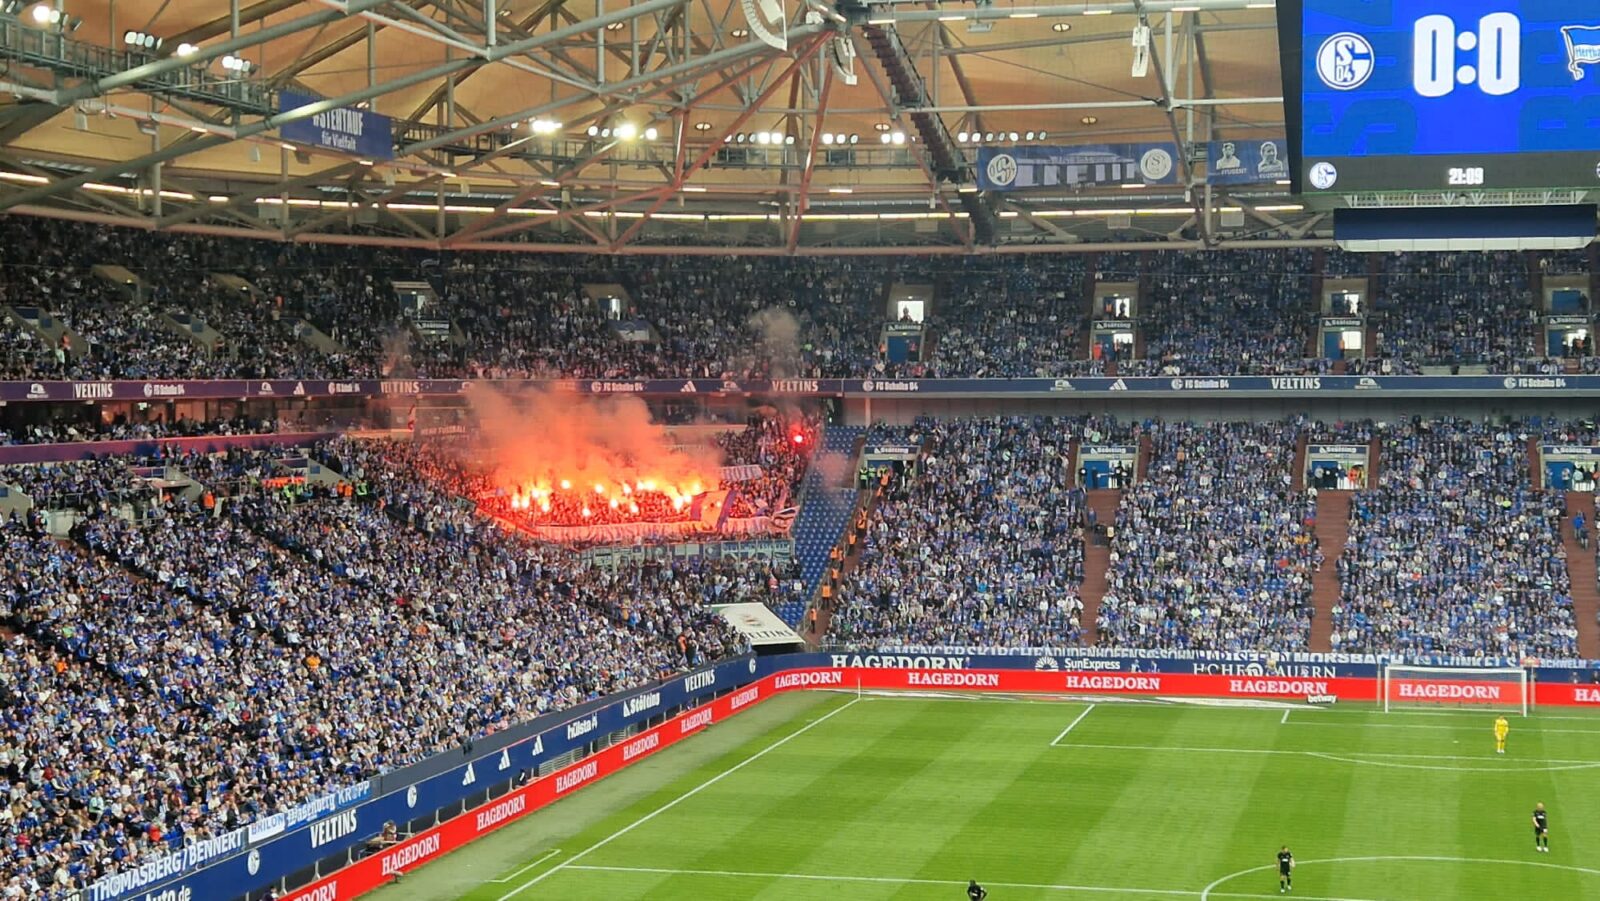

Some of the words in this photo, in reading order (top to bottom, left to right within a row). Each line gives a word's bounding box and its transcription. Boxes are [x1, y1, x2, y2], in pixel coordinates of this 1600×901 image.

[1413, 12, 1520, 97] 0:0
[321, 130, 332, 145] für
[332, 133, 356, 151] Vielfalt
[1448, 168, 1485, 185] 21:09
[75, 383, 113, 398] VELTINS
[771, 381, 818, 392] VELTINS
[1271, 378, 1321, 389] VELTINS
[747, 629, 793, 639] ELTINS
[831, 655, 963, 670] HAGEDORN
[1064, 657, 1120, 671] SunExpress
[684, 669, 715, 693] VELTINS
[775, 671, 843, 689] HAGEDORN
[908, 672, 999, 687] HAGEDORN
[1066, 675, 1160, 690] HAGEDORN
[1230, 679, 1328, 695] HAGEDORN
[1399, 683, 1500, 699] HAGEDORN
[630, 691, 660, 714] Stölting
[681, 707, 712, 734] HAGEDORN
[623, 731, 660, 761] HAGEDORN
[556, 760, 598, 794] HAGEDORN
[477, 793, 526, 831] HAGEDORN
[309, 808, 358, 849] VELTINS
[381, 832, 440, 876] HAGEDORN
